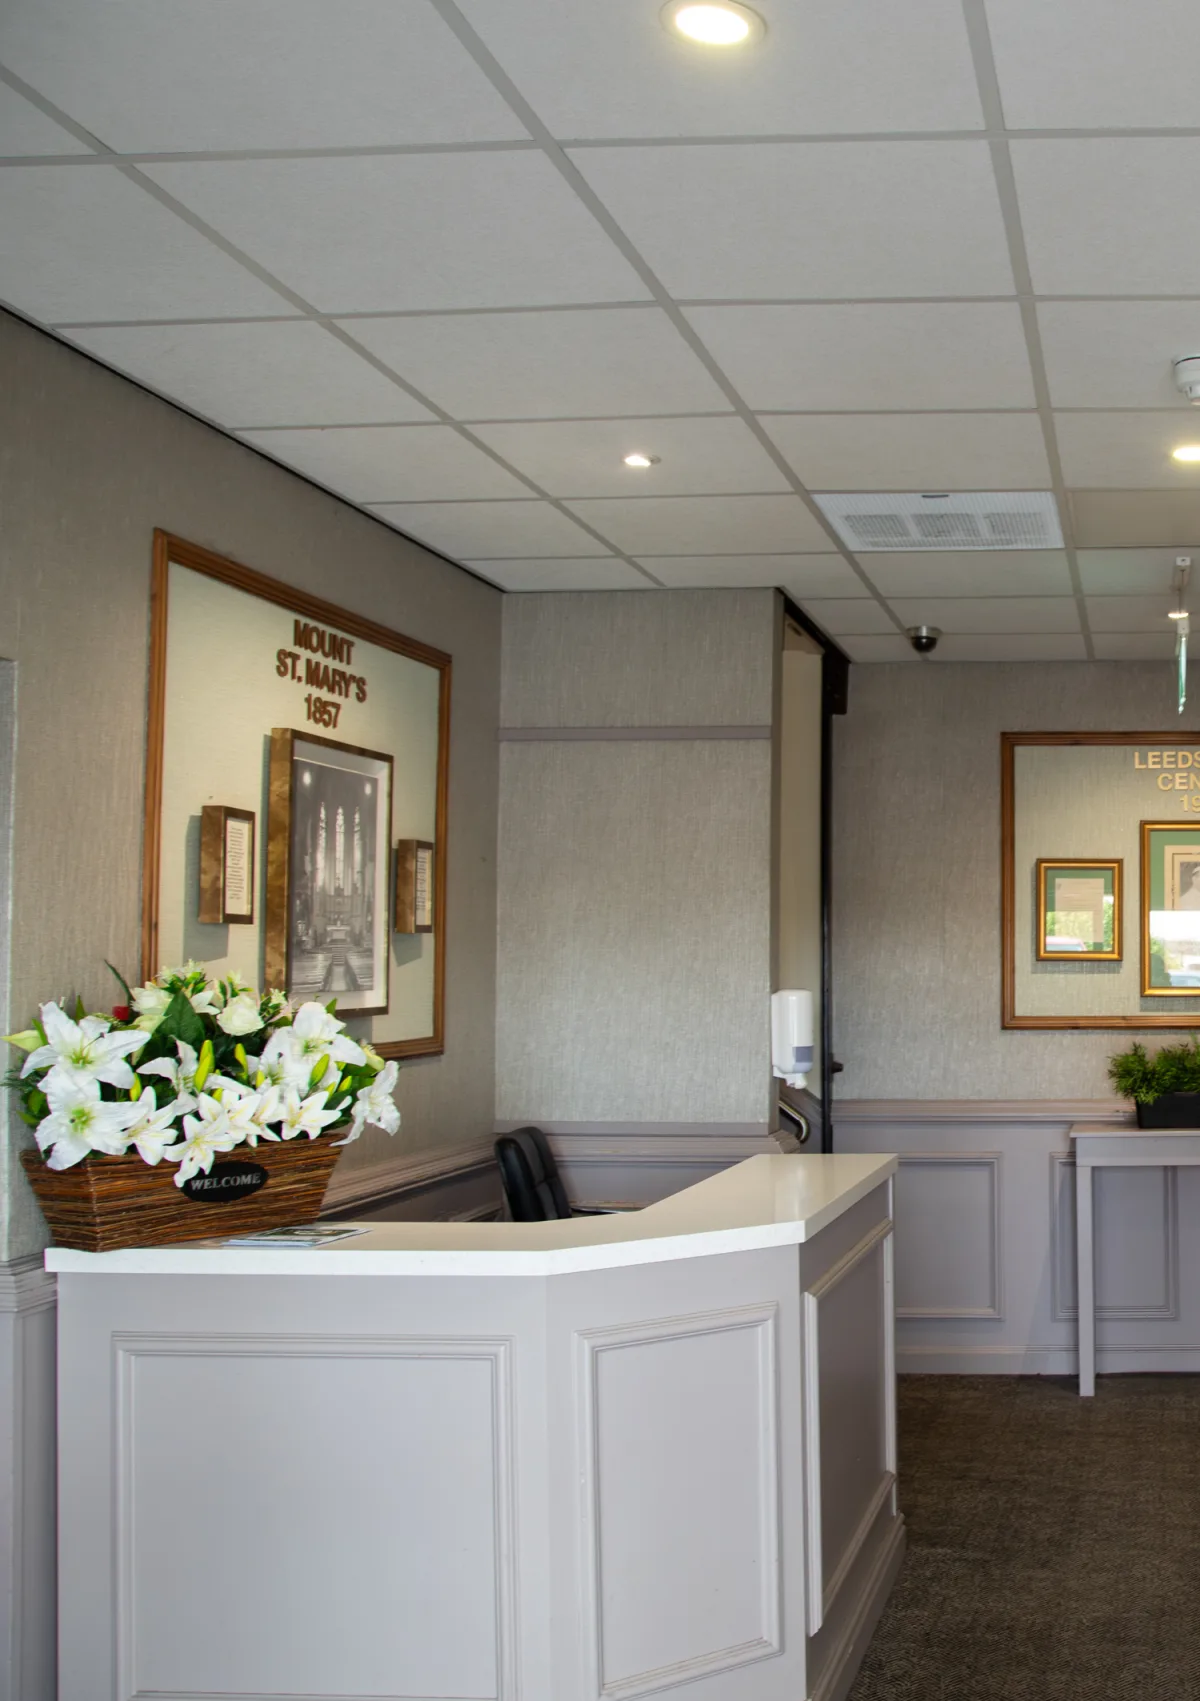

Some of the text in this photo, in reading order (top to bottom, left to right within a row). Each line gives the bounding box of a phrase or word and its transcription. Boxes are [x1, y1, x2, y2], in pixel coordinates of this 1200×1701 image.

[293, 619, 355, 665] MOUNT
[276, 648, 367, 703] ST. MARY'S
[304, 693, 342, 729] 1857
[190, 1172, 261, 1191] WELCOME
